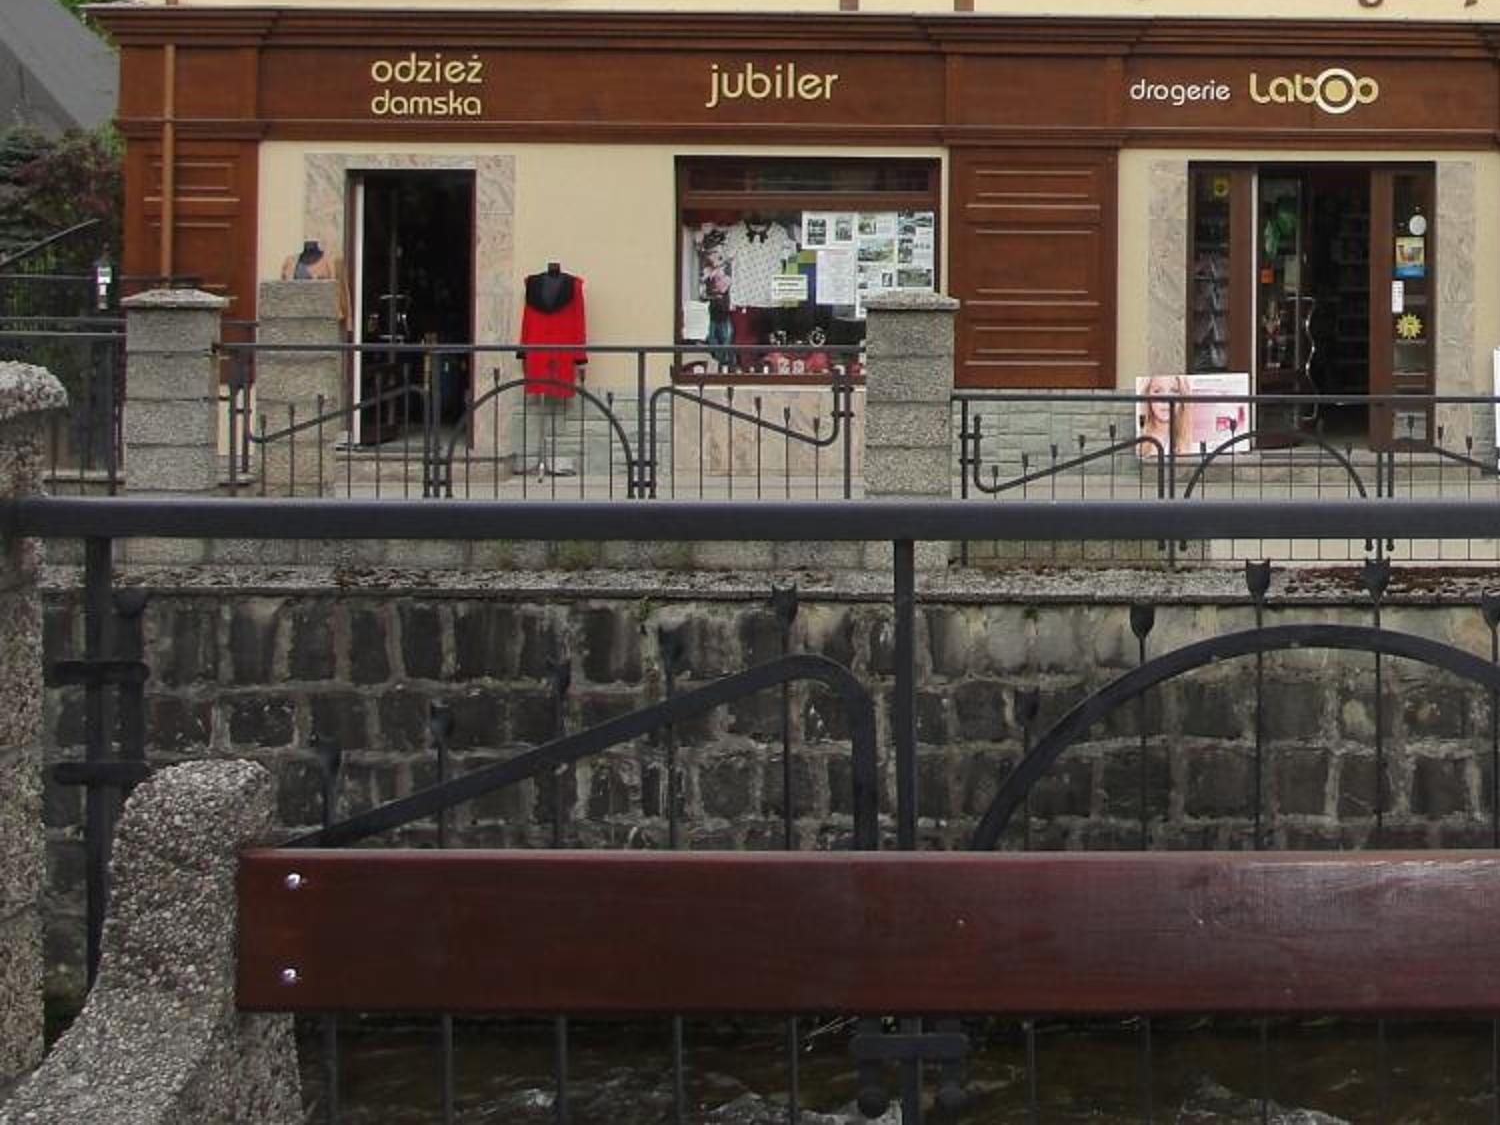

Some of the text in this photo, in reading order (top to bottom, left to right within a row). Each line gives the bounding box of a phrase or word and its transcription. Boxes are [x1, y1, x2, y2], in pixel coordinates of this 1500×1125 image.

[370, 52, 483, 84] odzież
[705, 62, 839, 108] jubiler
[1129, 78, 1231, 106] drogerie
[371, 89, 482, 116] damska
